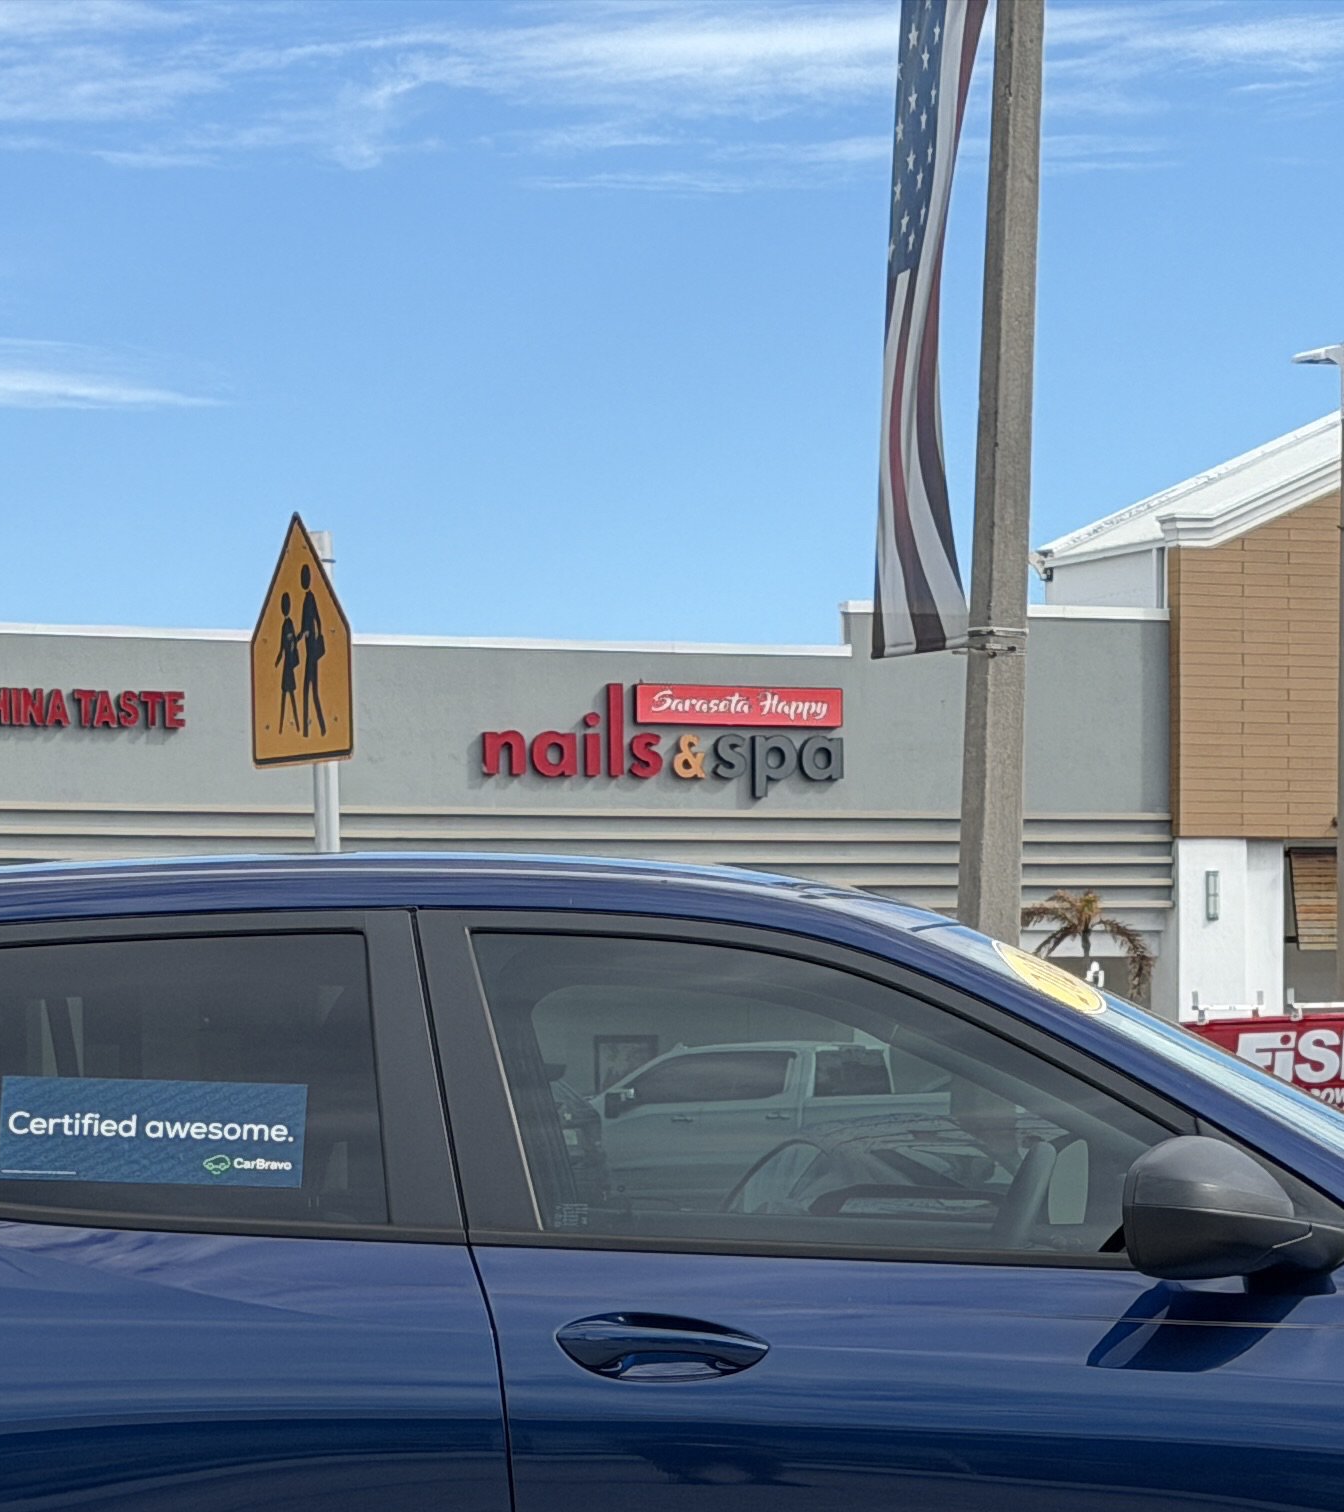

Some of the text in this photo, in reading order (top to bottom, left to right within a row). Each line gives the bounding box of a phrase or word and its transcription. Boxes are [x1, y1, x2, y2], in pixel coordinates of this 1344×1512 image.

[72, 688, 186, 729] TASTE
[651, 687, 829, 721] Sarasota Happy
[8, 1111, 295, 1143] Certified awesome.
[233, 1157, 292, 1171] CarBravo
